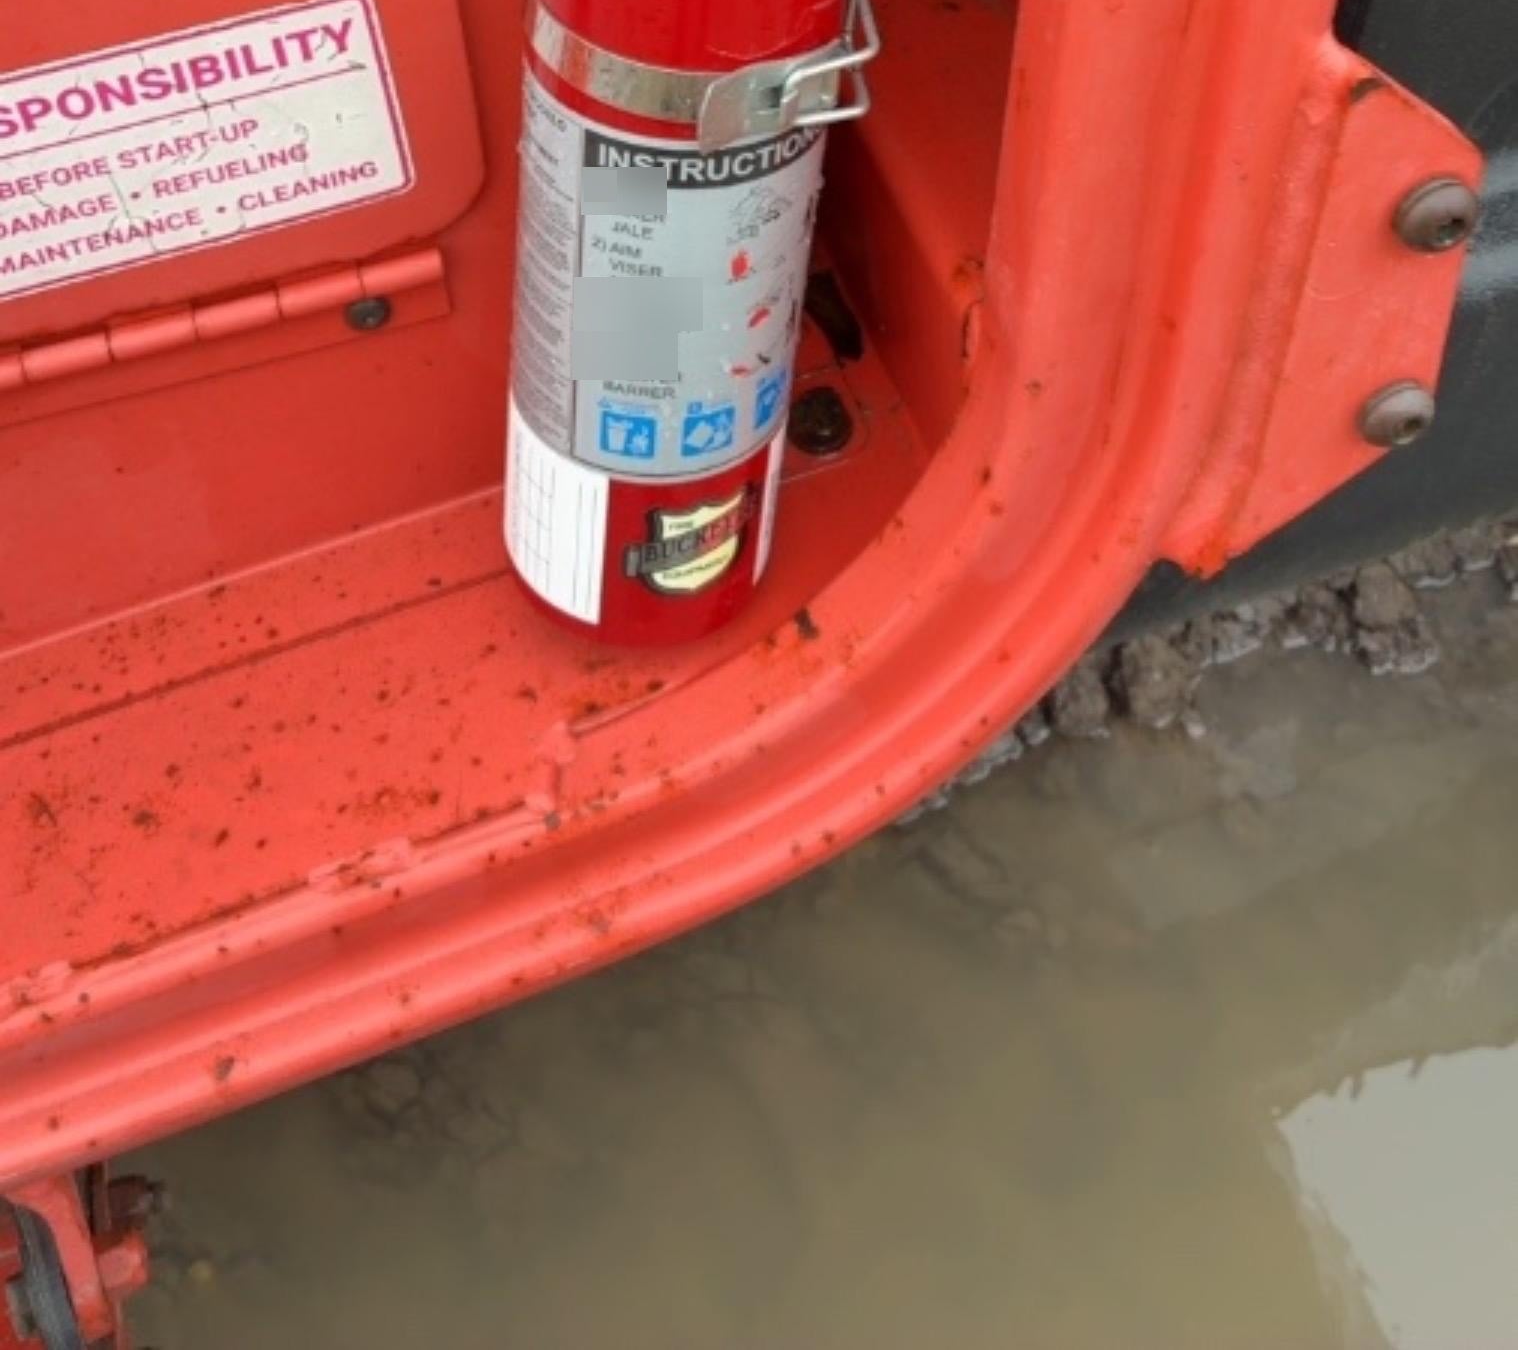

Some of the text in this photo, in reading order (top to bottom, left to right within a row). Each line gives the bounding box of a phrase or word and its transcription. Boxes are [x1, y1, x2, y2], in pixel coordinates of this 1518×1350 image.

[118, 119, 259, 170] START-UP
[152, 143, 309, 199] REFUELING
[238, 161, 379, 212] CLEANING
